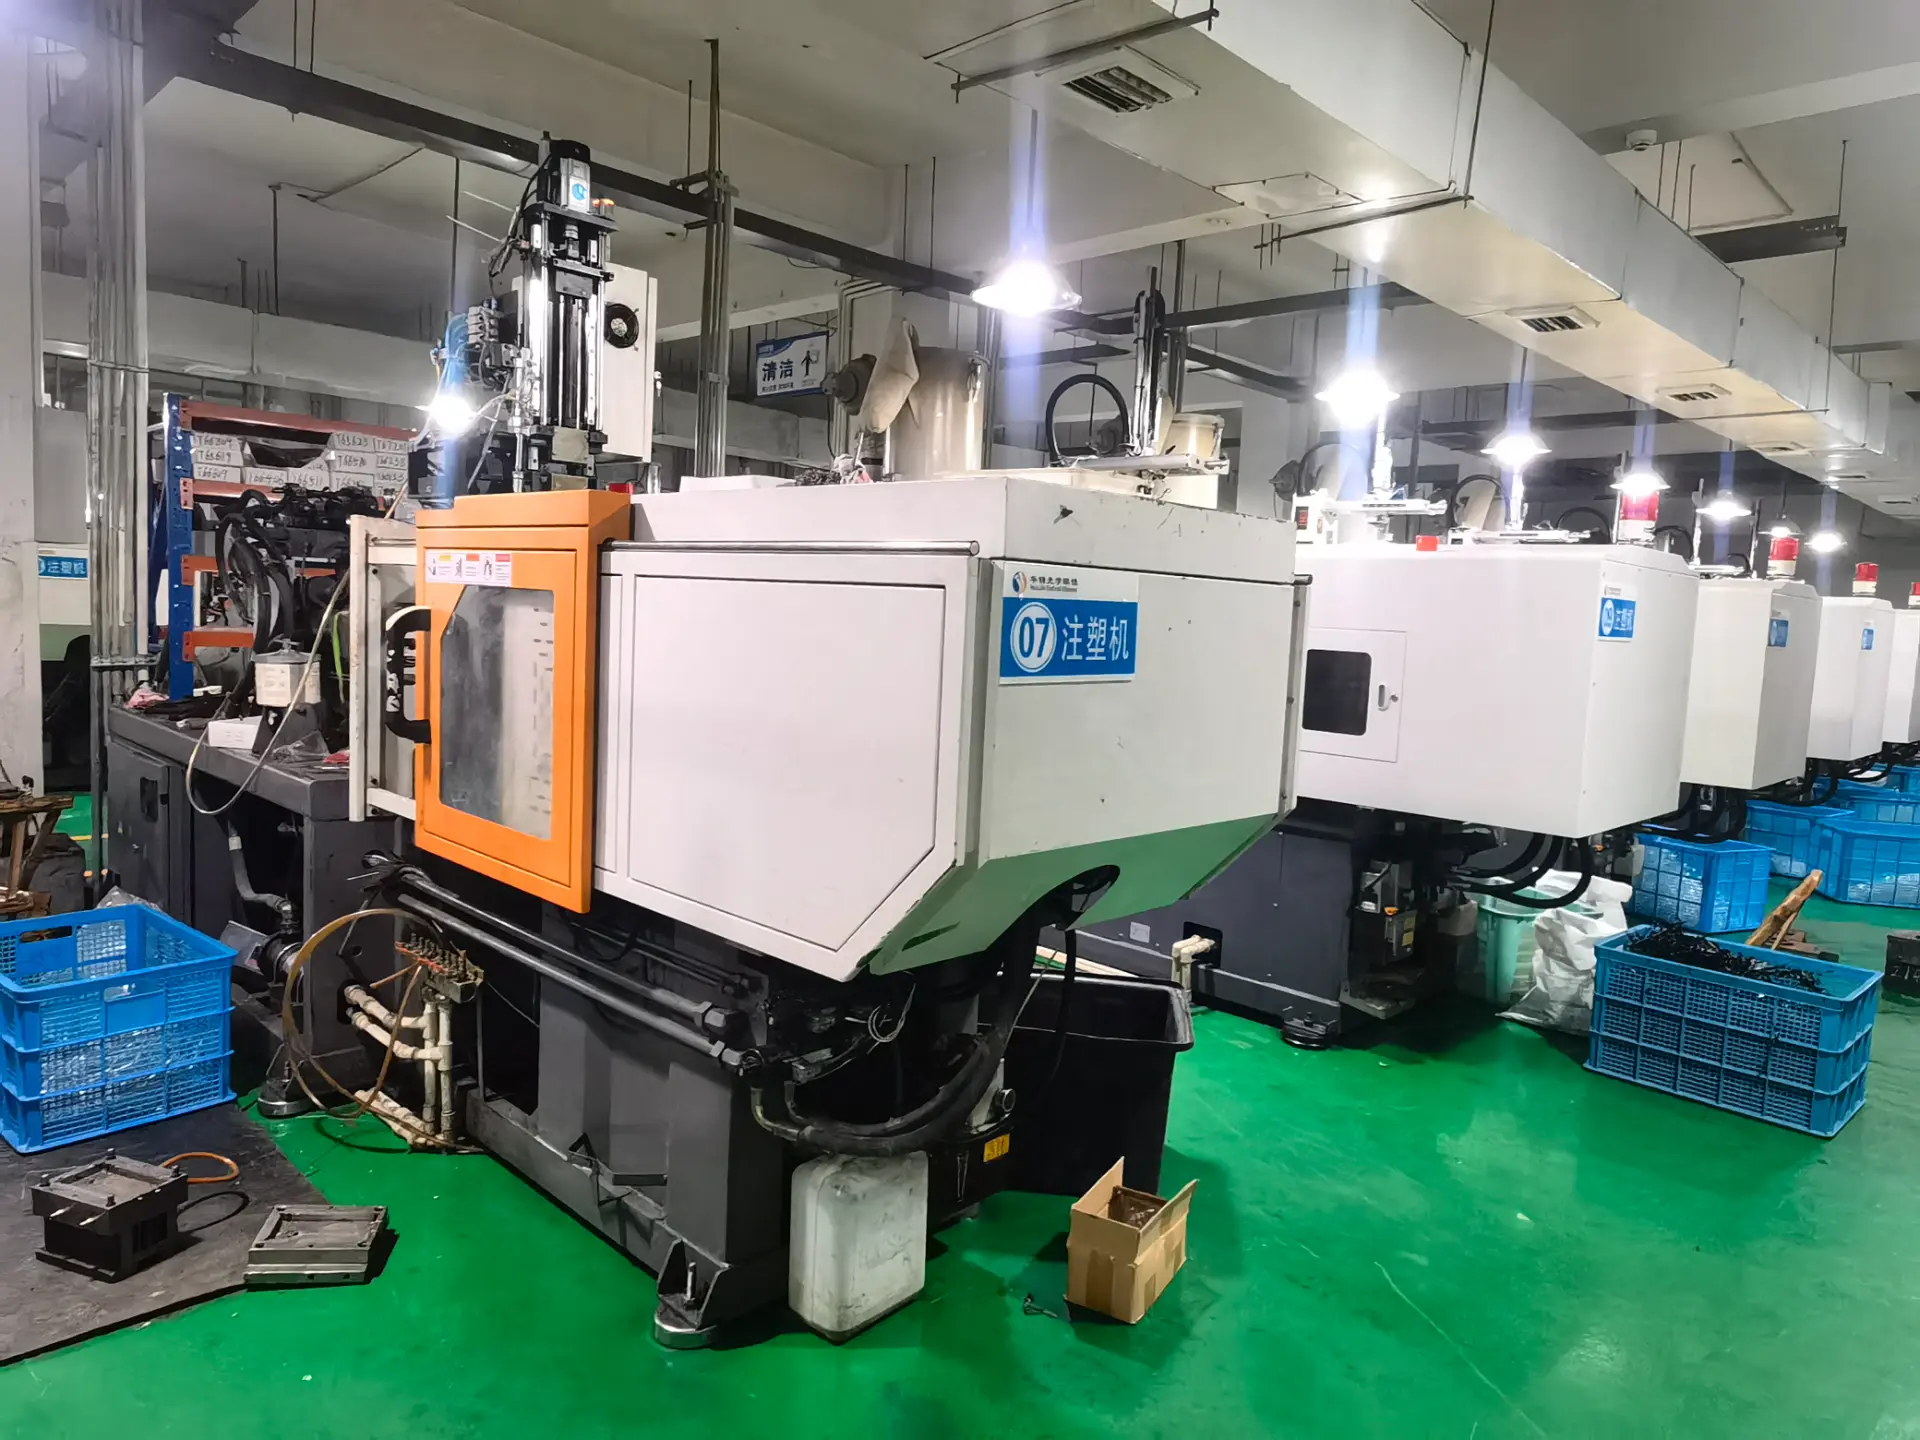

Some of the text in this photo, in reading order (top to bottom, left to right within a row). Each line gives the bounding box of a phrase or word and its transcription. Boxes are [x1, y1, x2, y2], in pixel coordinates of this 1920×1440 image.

[762, 358, 794, 382] 清洁
[1018, 614, 1129, 662] 07 注塑机
